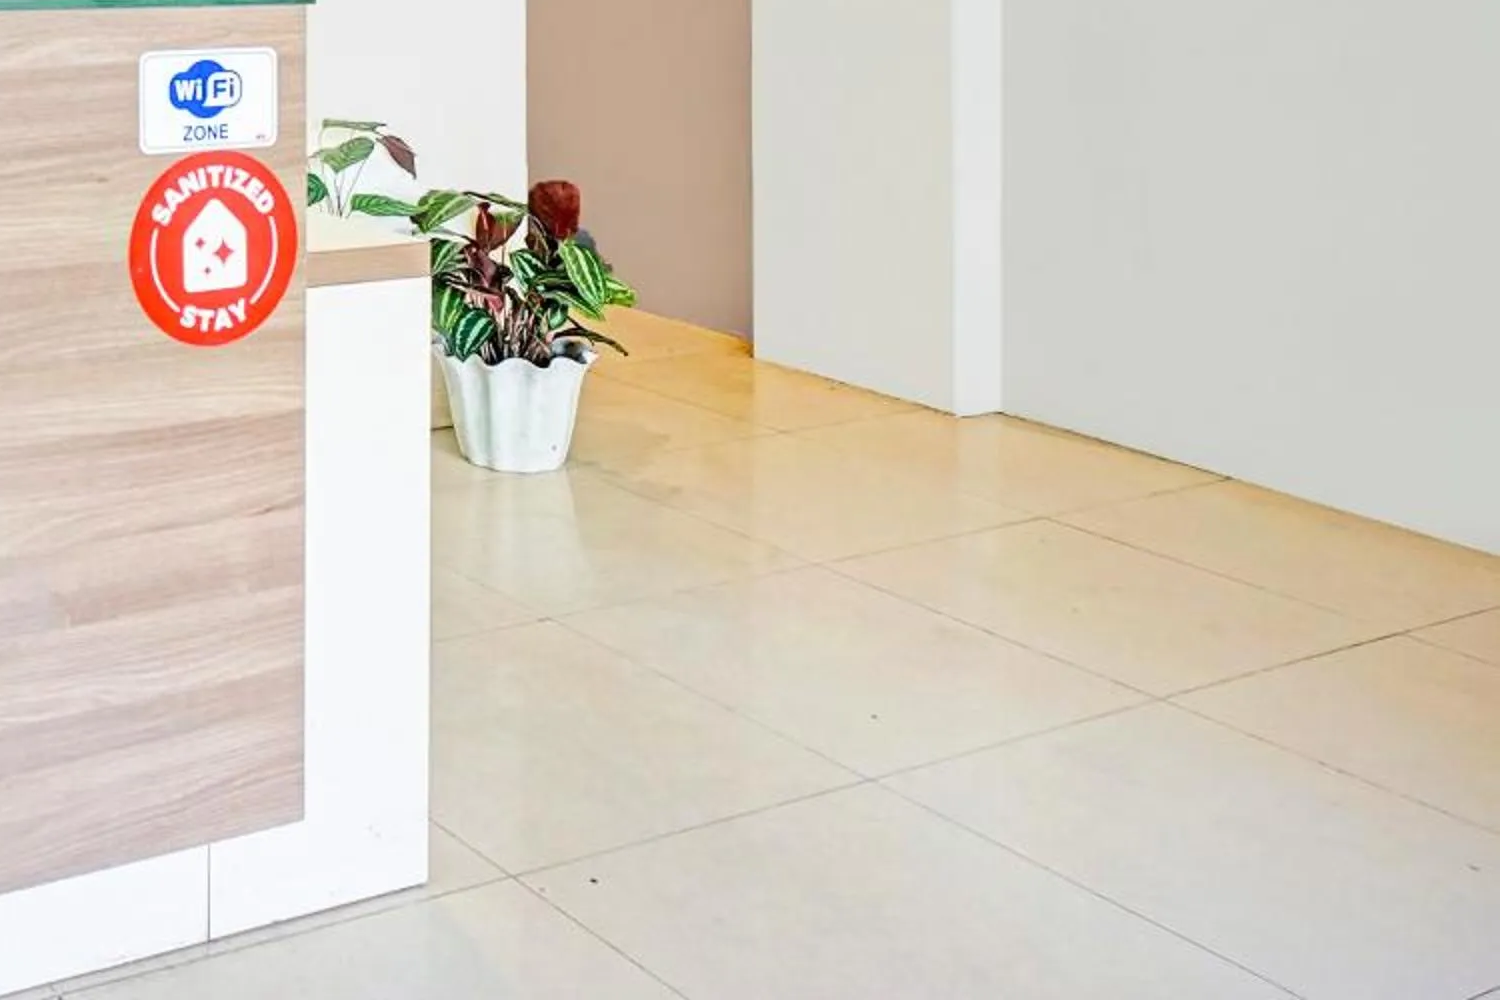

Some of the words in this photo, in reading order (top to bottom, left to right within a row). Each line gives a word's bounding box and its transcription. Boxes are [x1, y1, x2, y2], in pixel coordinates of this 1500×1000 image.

[183, 123, 229, 141] ZONE
[151, 165, 276, 227] SANITIZED
[179, 298, 248, 333] STAY
